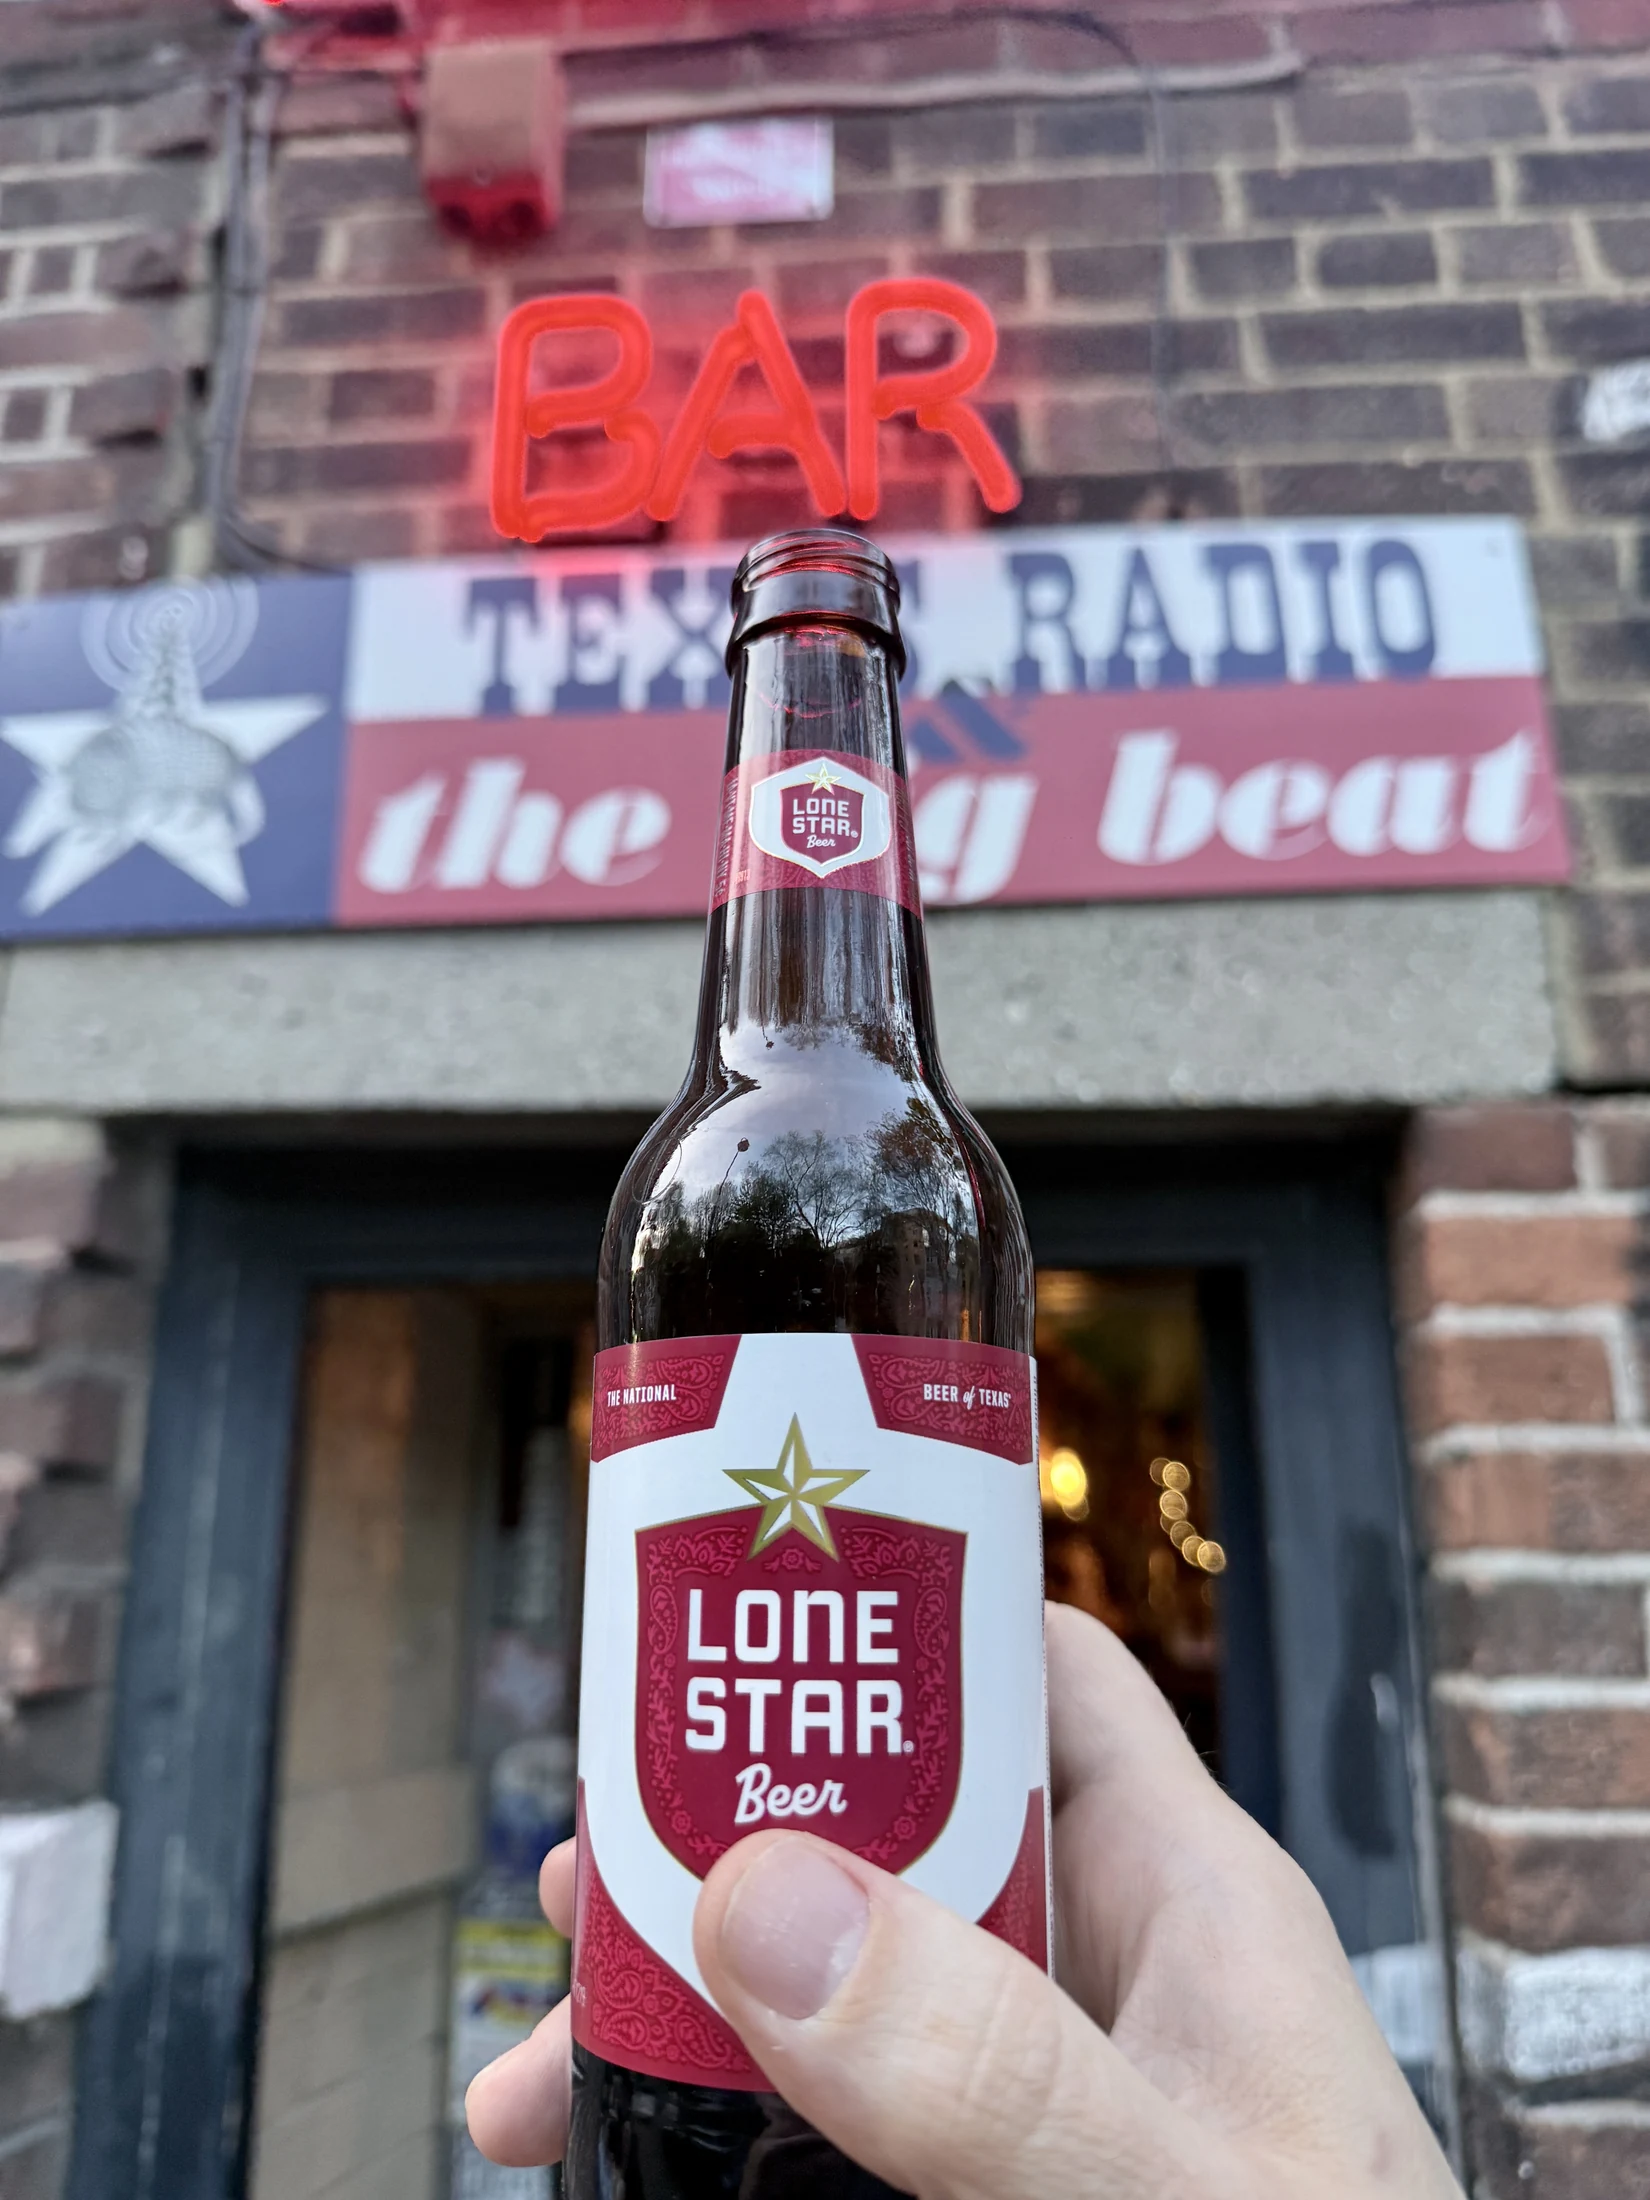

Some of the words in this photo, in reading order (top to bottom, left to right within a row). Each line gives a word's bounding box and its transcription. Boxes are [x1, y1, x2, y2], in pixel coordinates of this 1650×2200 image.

[492, 277, 1022, 542] BAR
[465, 562, 919, 718] TEX
[1006, 540, 1437, 692] RADIO
[357, 754, 674, 894] the
[1097, 725, 1552, 866] beat
[792, 798, 850, 818] LONE
[806, 834, 836, 849] Beer
[607, 1389, 621, 1407] THE
[623, 1383, 677, 1404] NATIONAL
[923, 1383, 959, 1403] BEER
[962, 1385, 976, 1411] of
[687, 1588, 899, 1664] LONE
[733, 1762, 848, 1826] Beer
